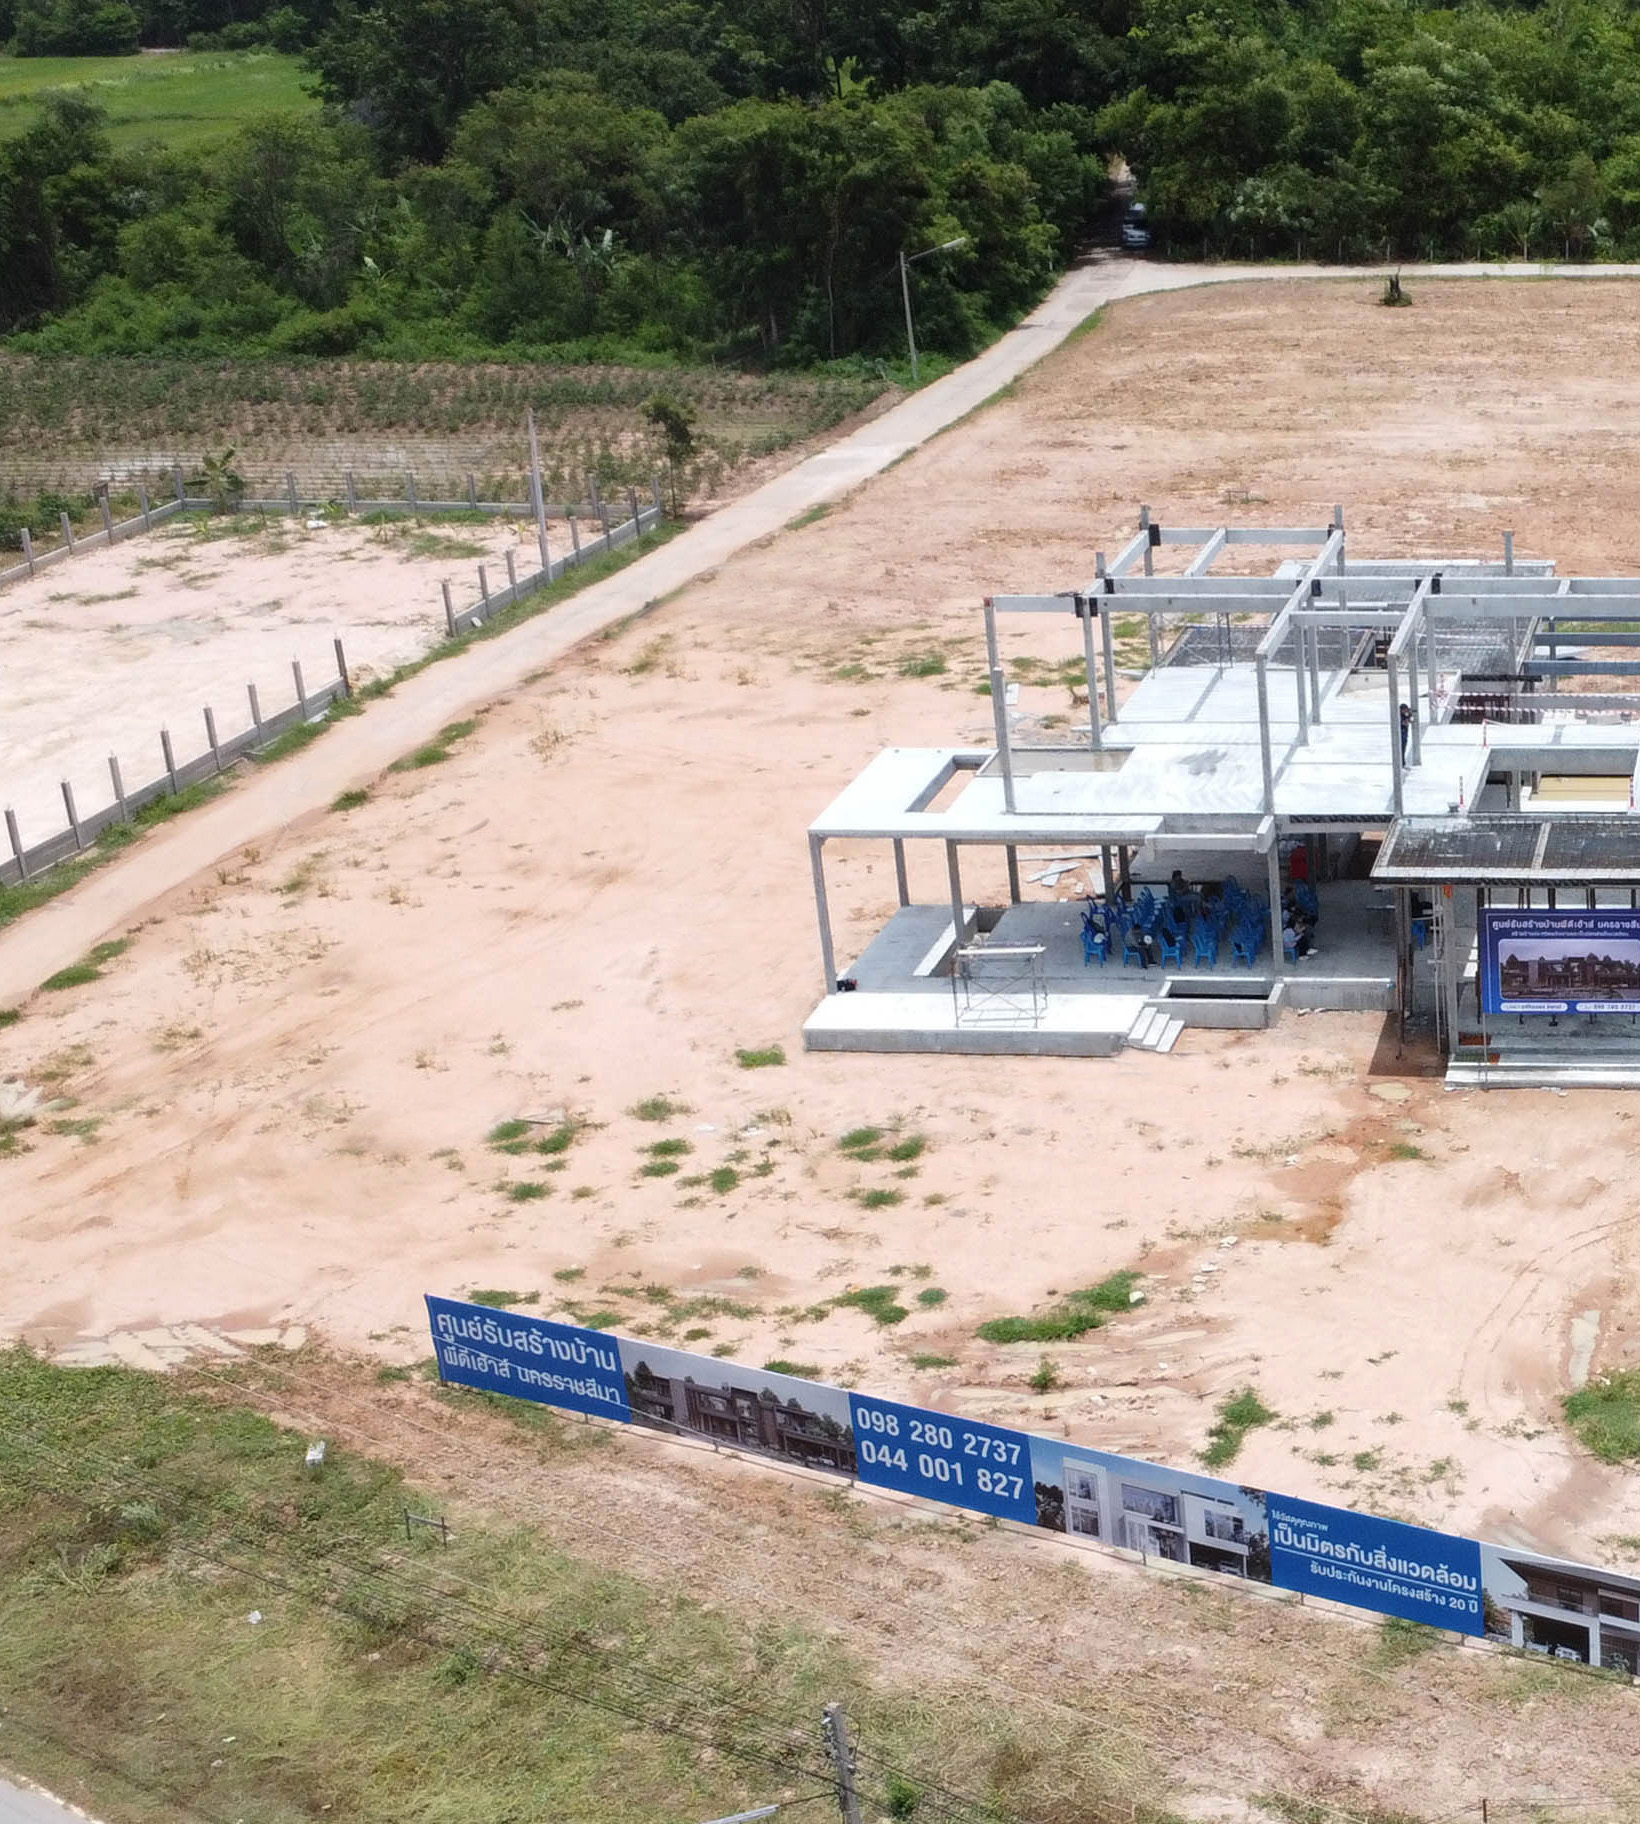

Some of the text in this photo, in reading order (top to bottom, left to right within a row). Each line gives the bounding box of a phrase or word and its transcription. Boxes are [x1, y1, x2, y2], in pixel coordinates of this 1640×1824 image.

[436, 1313, 617, 1372] ศูนย์รับสร้างบ้าน
[517, 1366, 621, 1405] นครราชสีมา
[856, 1407, 1021, 1466] 098 280 2737
[861, 1440, 1024, 1500] 044 001 827
[1273, 1524, 1477, 1592] เป็นมิตรกับสิ่งแวดล้อม
[1310, 1562, 1479, 1614] รับประกันงานโครงสร้าง 20 ปี
